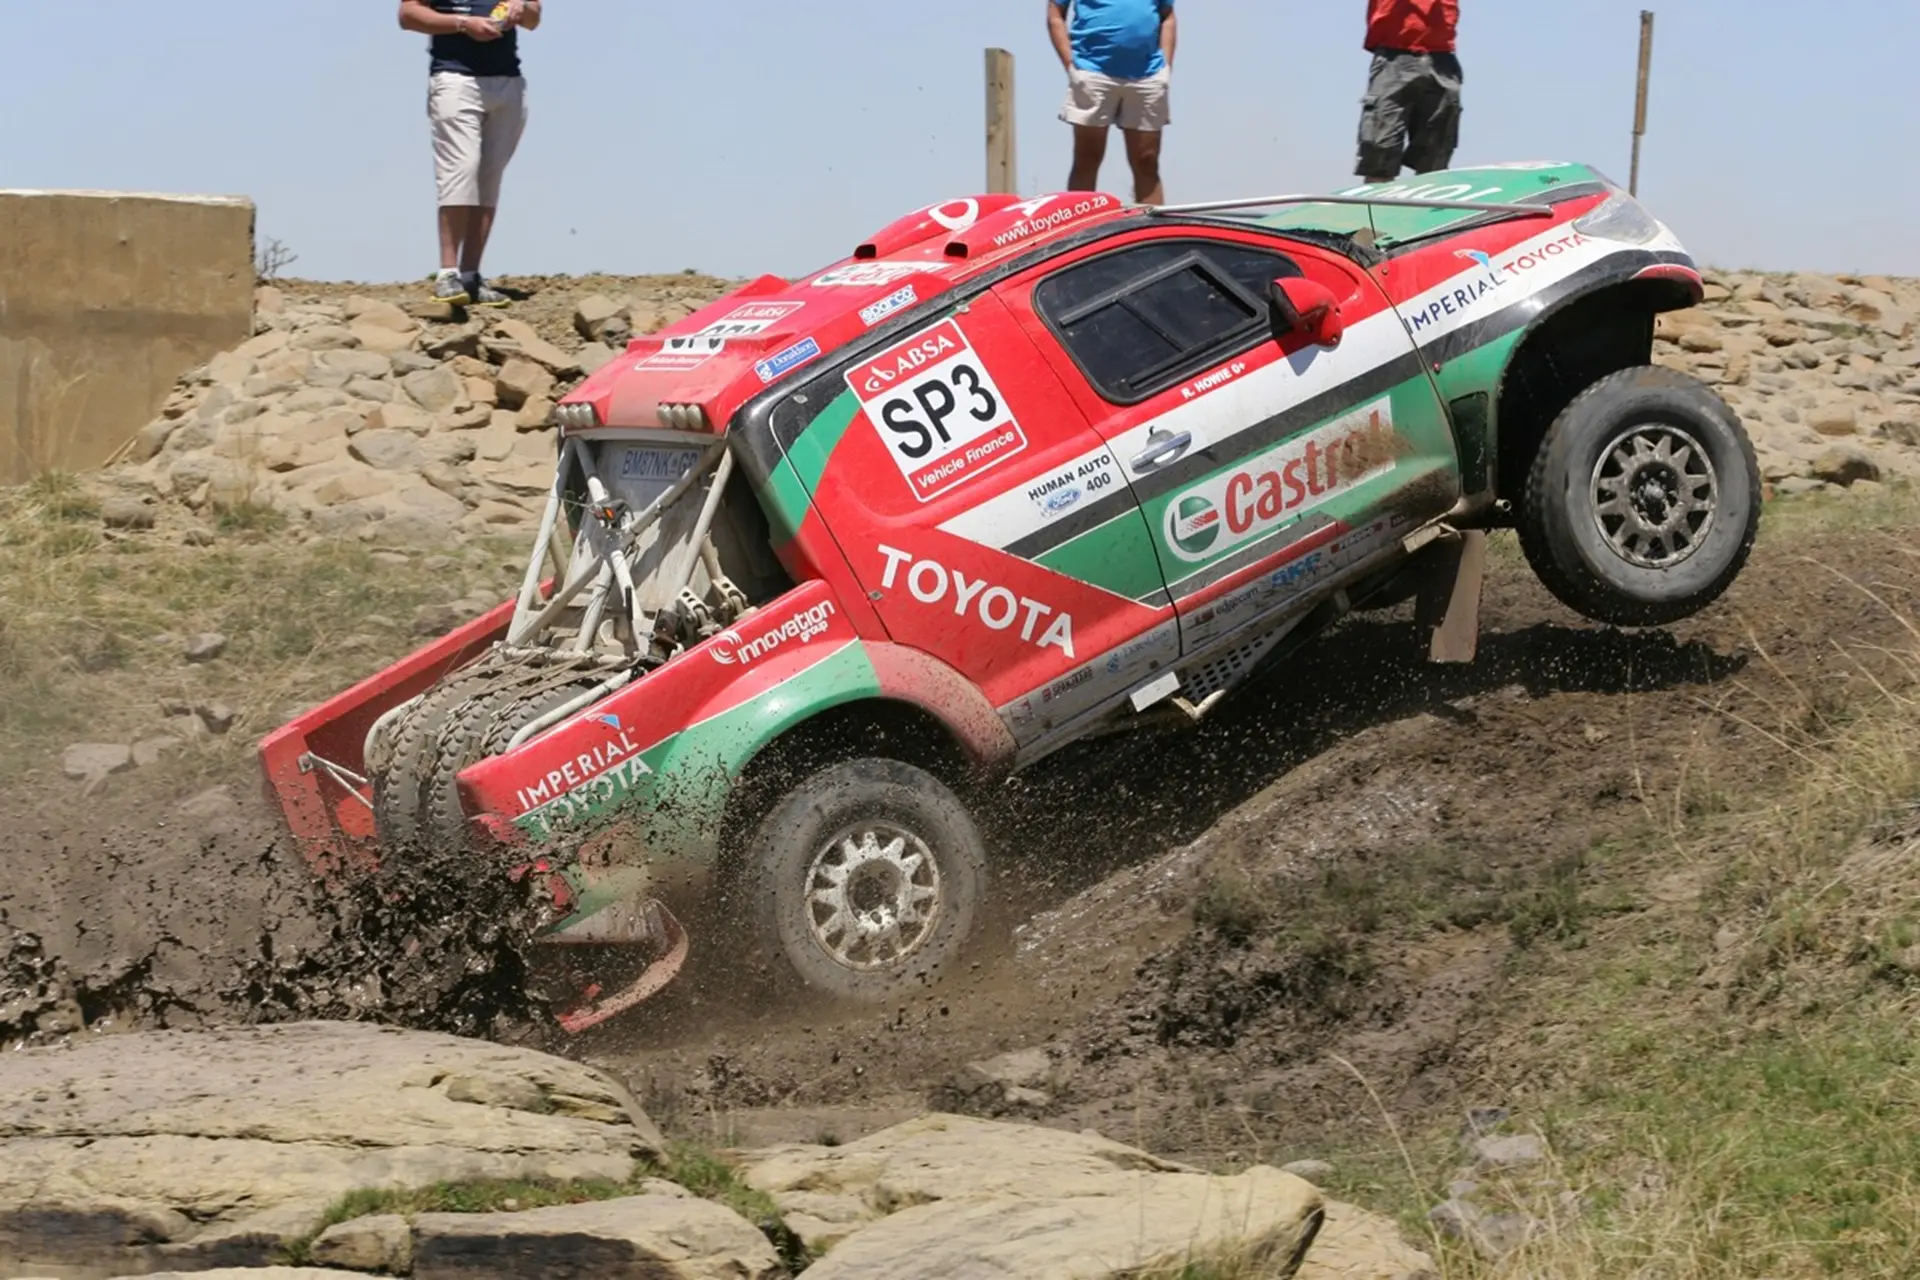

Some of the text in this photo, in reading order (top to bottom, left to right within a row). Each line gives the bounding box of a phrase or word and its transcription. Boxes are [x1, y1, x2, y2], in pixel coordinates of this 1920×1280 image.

[992, 194, 1109, 247] www.toyota.co.za
[1402, 233, 1591, 335] IMPERIAL TOYOTA
[897, 334, 956, 375] ABSA
[1194, 367, 1233, 392] HOWIE
[881, 363, 997, 459] SP3
[917, 430, 1016, 488] Vehicle Finance
[1028, 454, 1111, 501] HUMAN AUTO
[1086, 472, 1112, 492] 400
[876, 543, 1076, 660] TOYOTA
[736, 599, 836, 665] innovation
[800, 620, 829, 644] group
[516, 731, 639, 810] IMPERIAL
